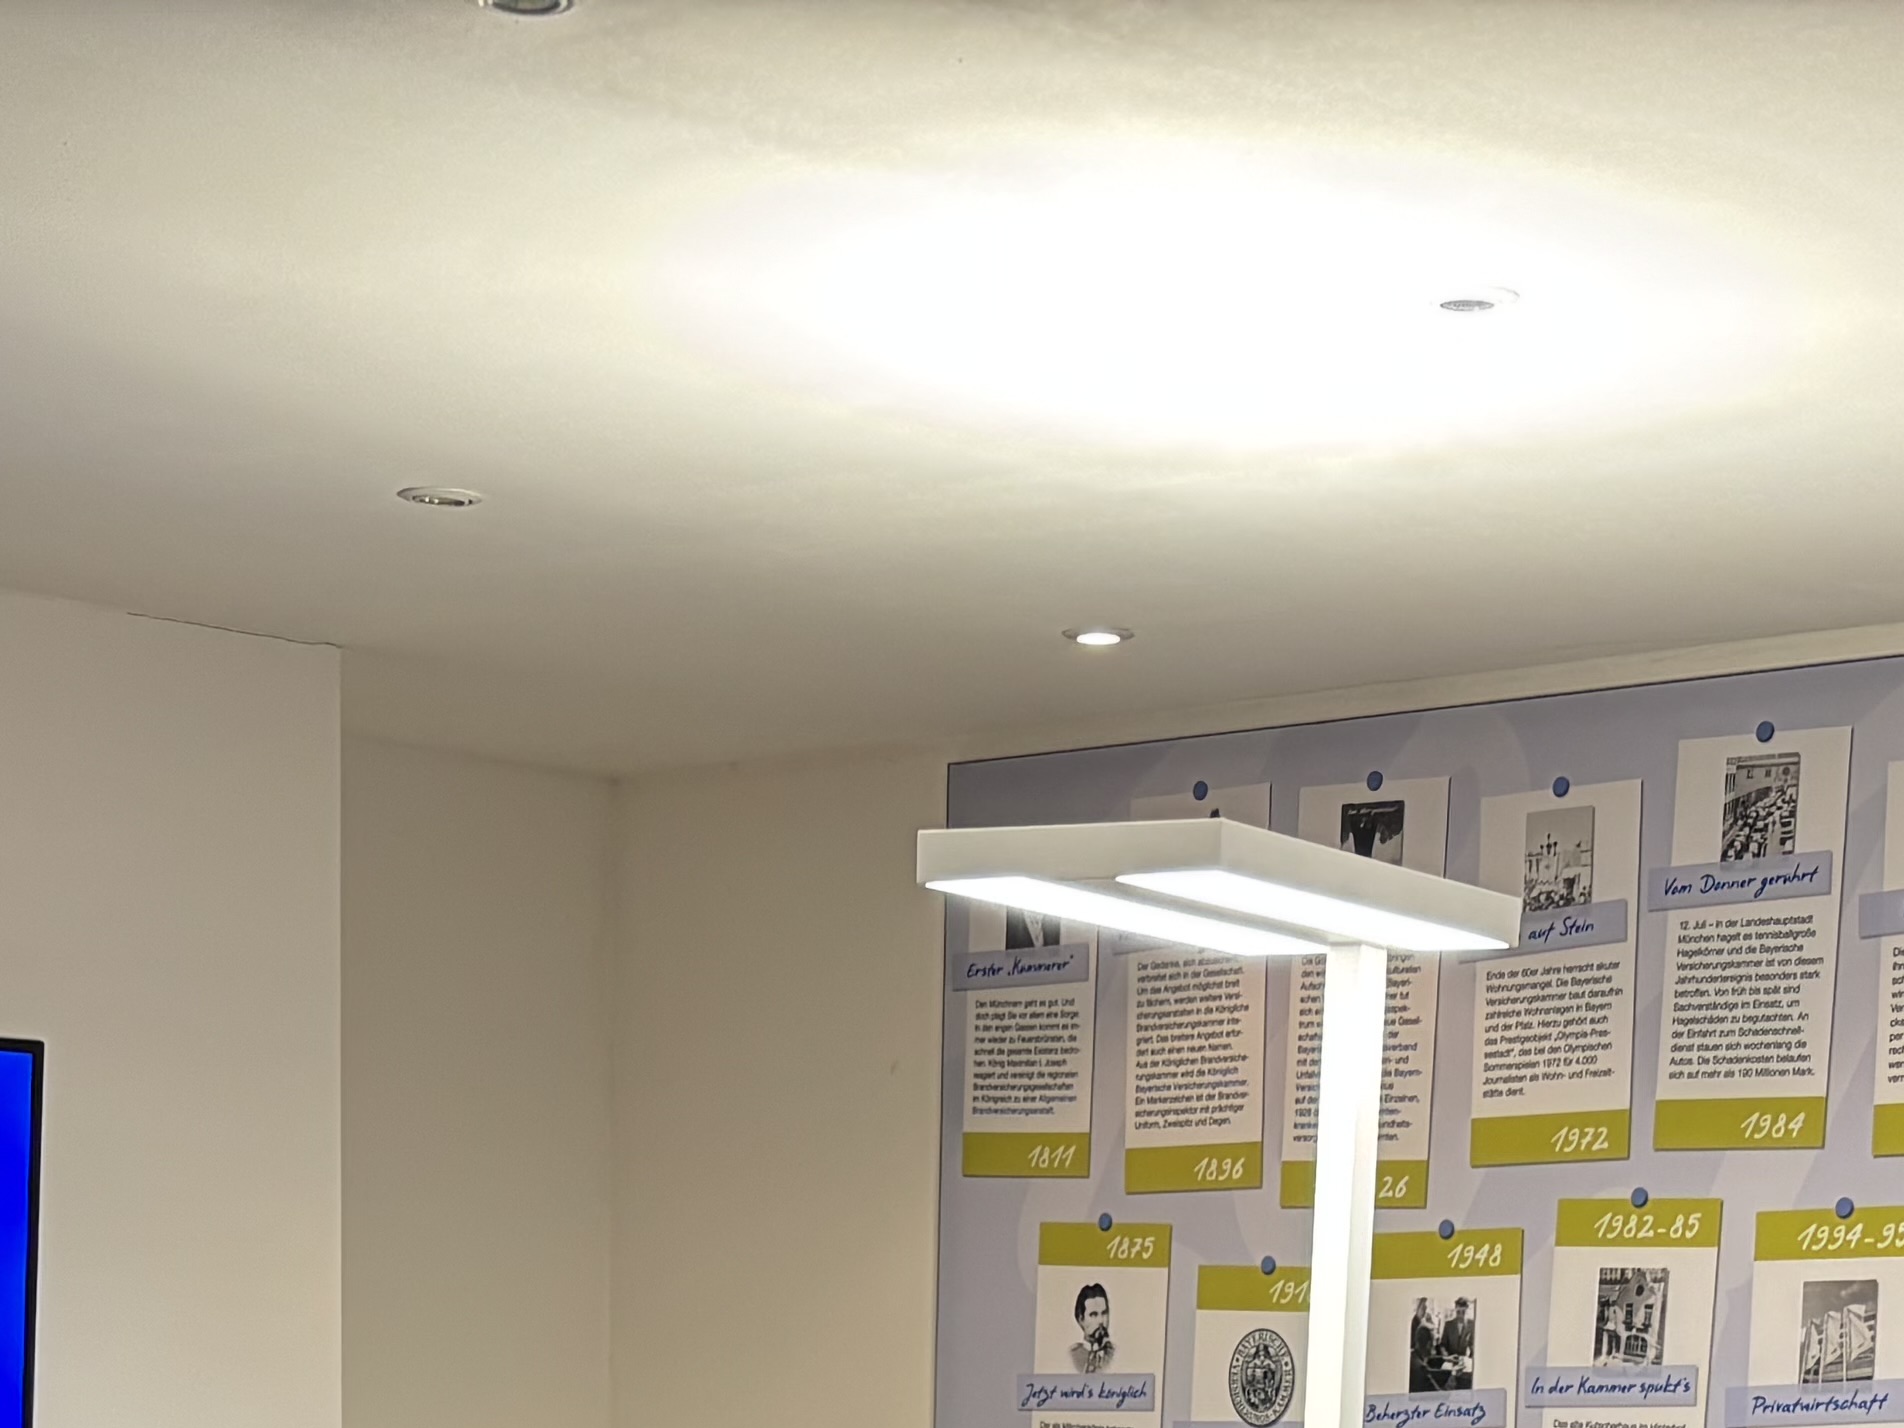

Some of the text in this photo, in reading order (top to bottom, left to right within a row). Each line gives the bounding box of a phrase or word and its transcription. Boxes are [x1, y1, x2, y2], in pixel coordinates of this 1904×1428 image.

[1665, 878, 1692, 895] Vom
[1700, 874, 1756, 894] Donner
[1528, 916, 1594, 943] auf Stein
[967, 963, 1003, 978] Erster
[1741, 1113, 1805, 1138] 1984
[1552, 1127, 1608, 1152] 1972
[1029, 1146, 1076, 1167] 1811
[1195, 1158, 1244, 1180] 1896
[1595, 1213, 1701, 1238] 1982-85
[1107, 1236, 1154, 1259] 1875
[1448, 1244, 1501, 1268] 1948
[1267, 1279, 1311, 1304] 191
[1021, 1383, 1057, 1407] Jetzt
[1531, 1377, 1544, 1394] In
[1548, 1377, 1573, 1394] der
[1577, 1376, 1636, 1394] Kammer
[1752, 1389, 1888, 1414] Privatwirtschaft
[1364, 1402, 1486, 1428] Beherzter Einsatz
